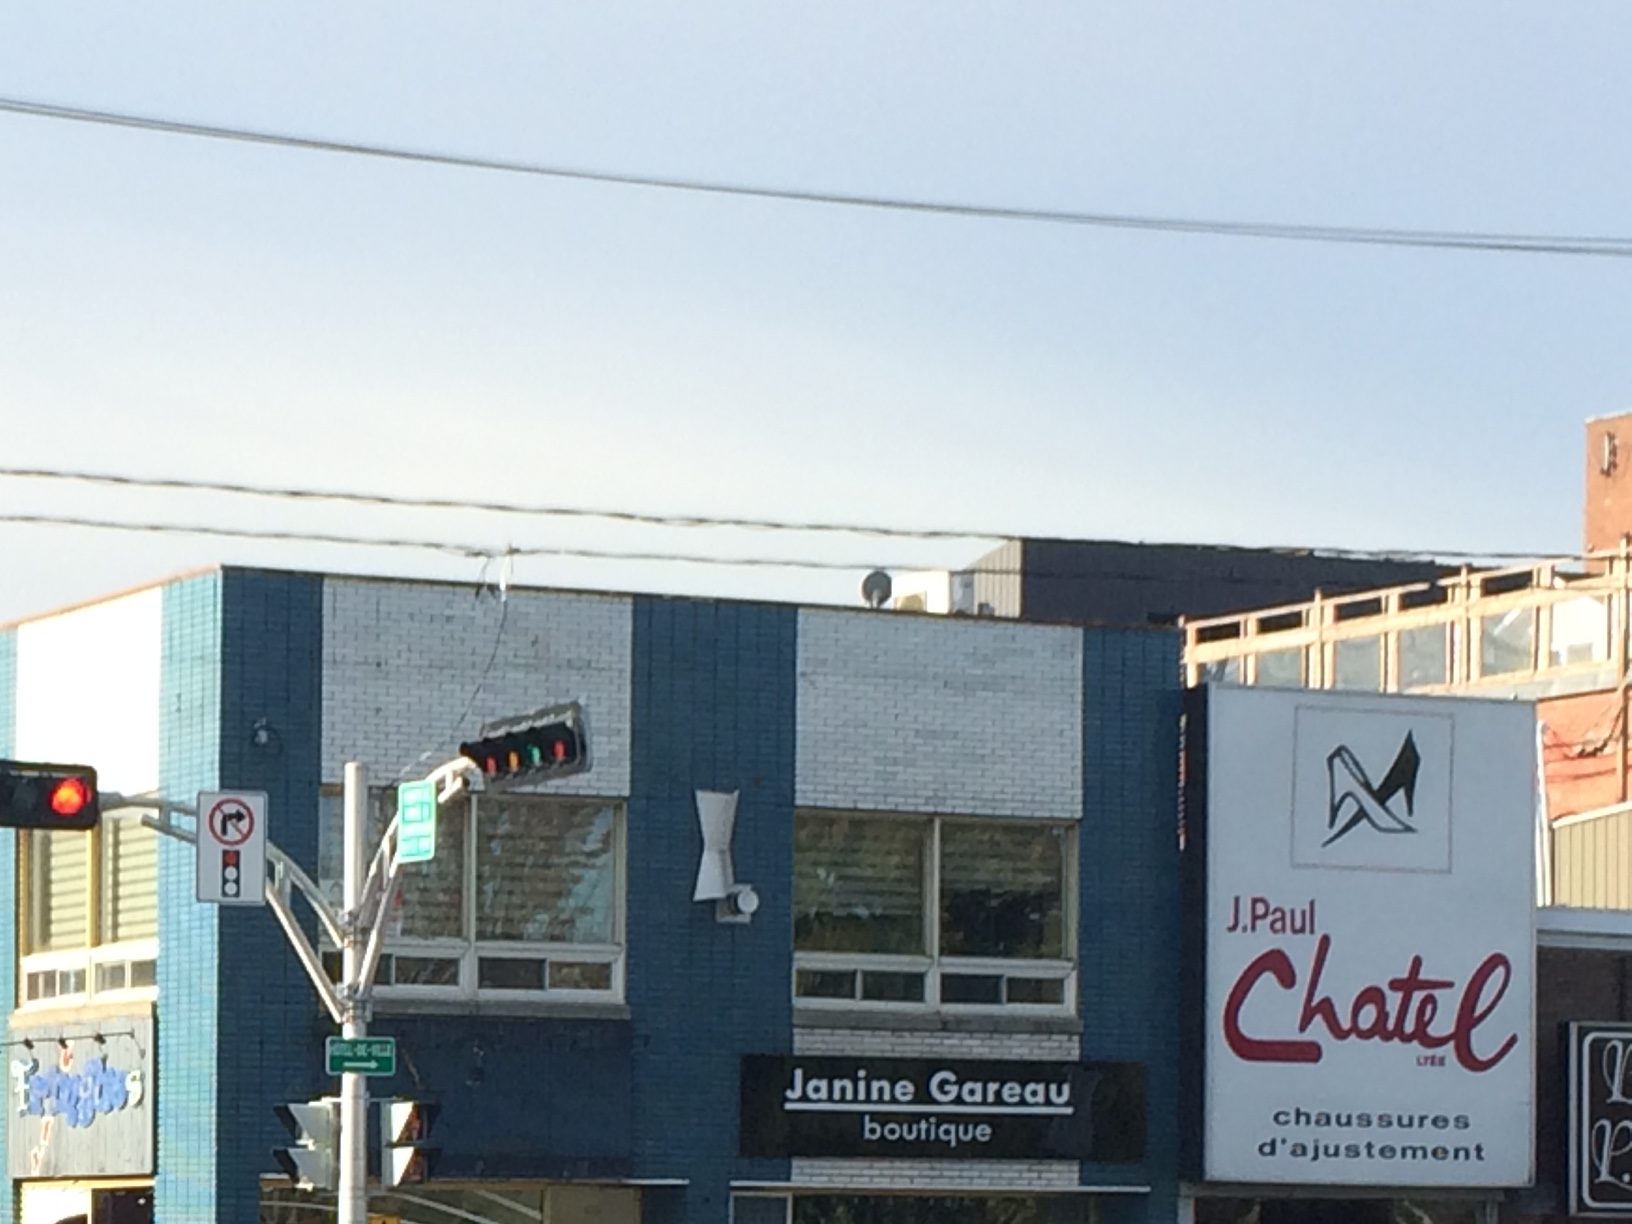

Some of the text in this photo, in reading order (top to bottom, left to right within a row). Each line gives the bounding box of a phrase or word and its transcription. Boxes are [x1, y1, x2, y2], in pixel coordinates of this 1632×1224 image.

[1223, 933, 1518, 1072] Chatel
[784, 1067, 1070, 1106] Janine Gareau
[863, 1114, 992, 1148] boutique
[1272, 1107, 1471, 1130] chaussures
[1257, 1138, 1485, 1162] d'ajustement
